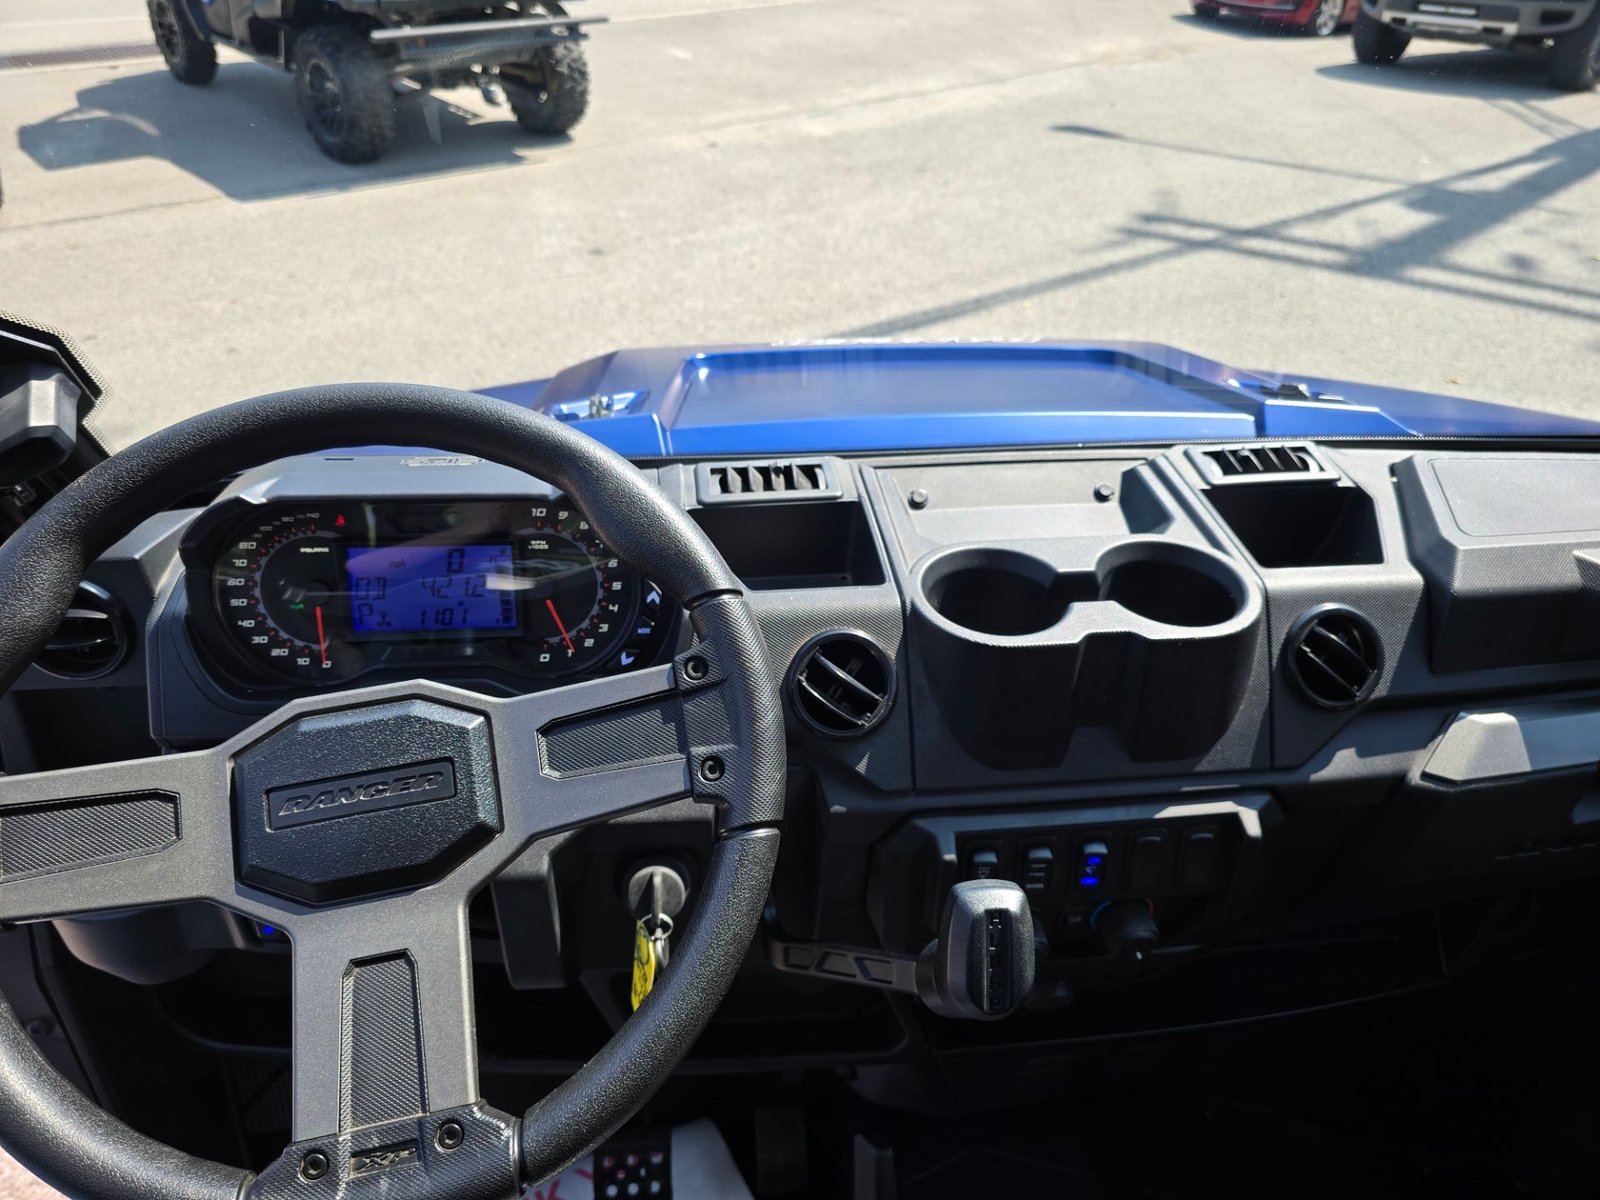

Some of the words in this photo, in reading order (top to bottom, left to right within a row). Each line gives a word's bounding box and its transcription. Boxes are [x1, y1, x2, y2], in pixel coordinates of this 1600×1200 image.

[531, 508, 546, 517] 10
[558, 511, 568, 519] 9
[580, 521, 589, 530] 8
[238, 542, 256, 550] 80
[232, 559, 247, 567] 70
[447, 549, 465, 573] 0
[608, 559, 618, 568] 6
[227, 578, 244, 586] 60
[612, 582, 622, 590] 5
[230, 598, 247, 606] 50
[608, 604, 618, 613] 4
[237, 620, 255, 628] 40
[598, 624, 609, 632] 3
[251, 636, 268, 644] 30
[584, 639, 594, 647] 2
[540, 653, 550, 662] 0
[296, 658, 310, 666] 10
[322, 660, 331, 669] 0
[277, 770, 445, 816] RANGER
